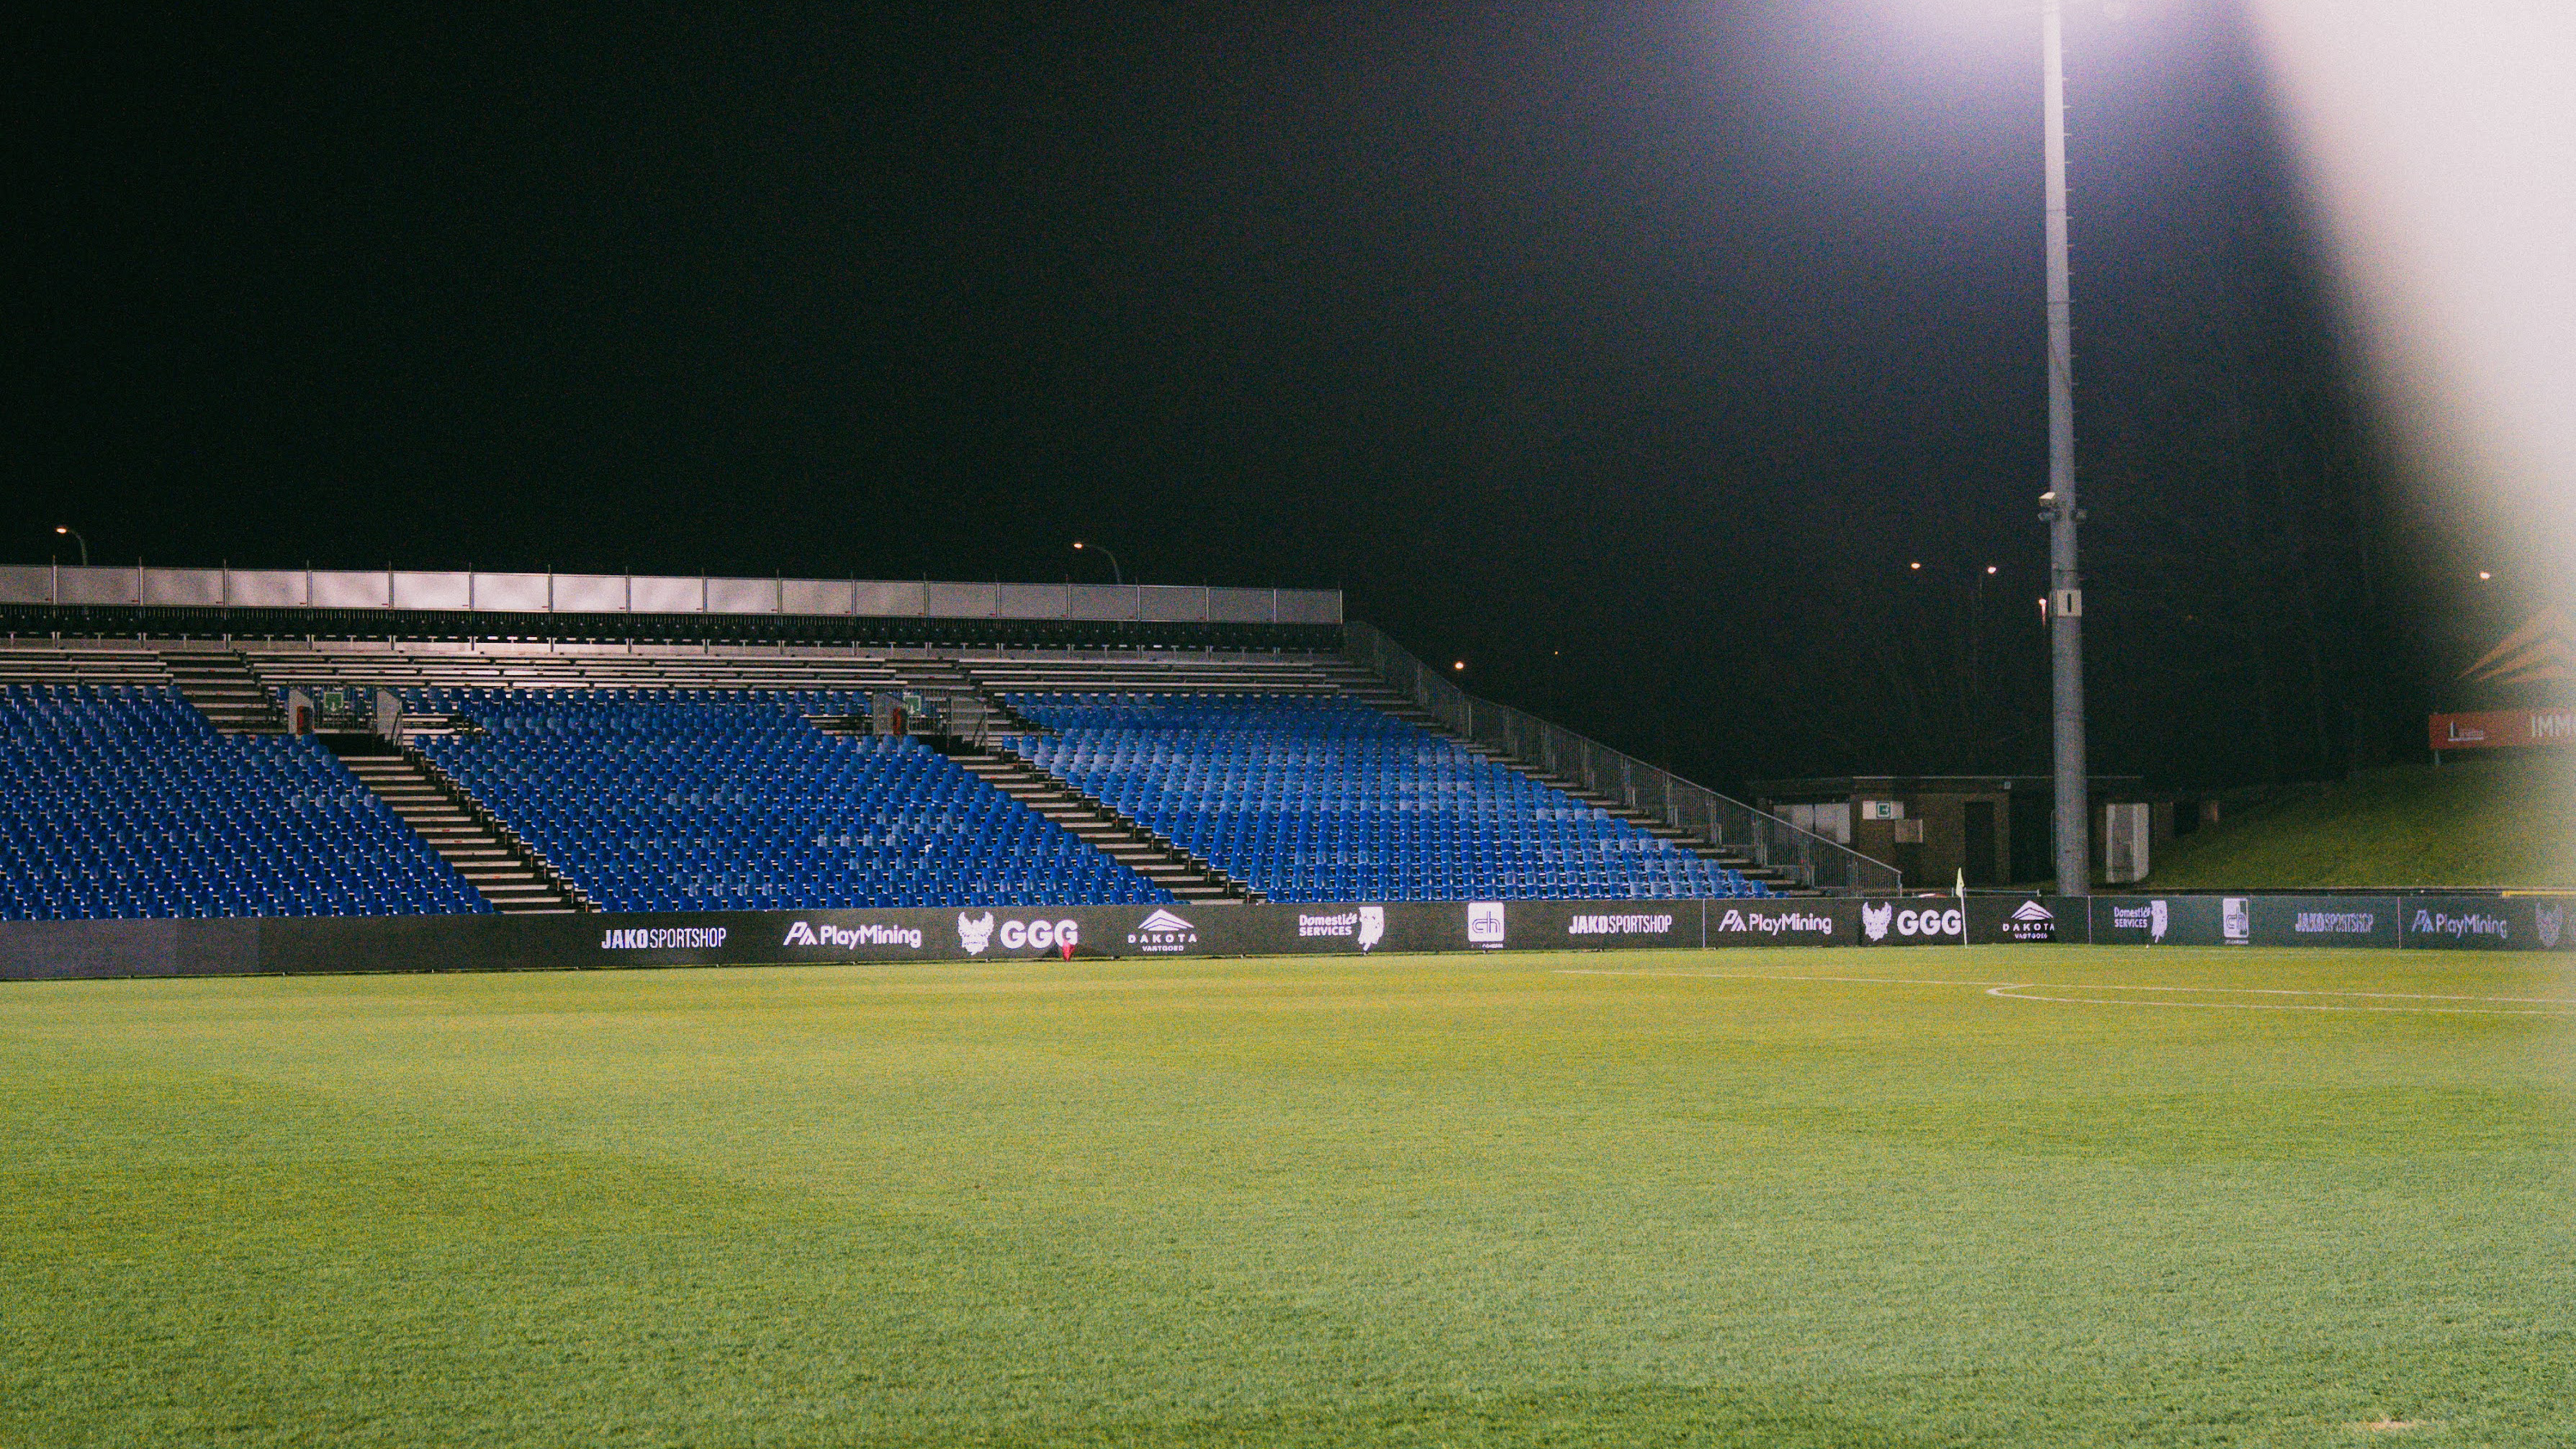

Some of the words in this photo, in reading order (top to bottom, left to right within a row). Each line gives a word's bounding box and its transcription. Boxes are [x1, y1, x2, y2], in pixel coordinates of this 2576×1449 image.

[1000, 919, 1078, 949] GGG
[1299, 926, 1353, 936] SERVICES
[1749, 913, 1832, 936] PlayMining
[1897, 909, 1962, 936] GGG
[2002, 923, 2055, 932] DAKOTA
[2115, 918, 2148, 929] SERVICES
[2436, 913, 2507, 939] PlayMining
[820, 924, 922, 949] PlayMining
[1128, 934, 1197, 944] DAKOTA
